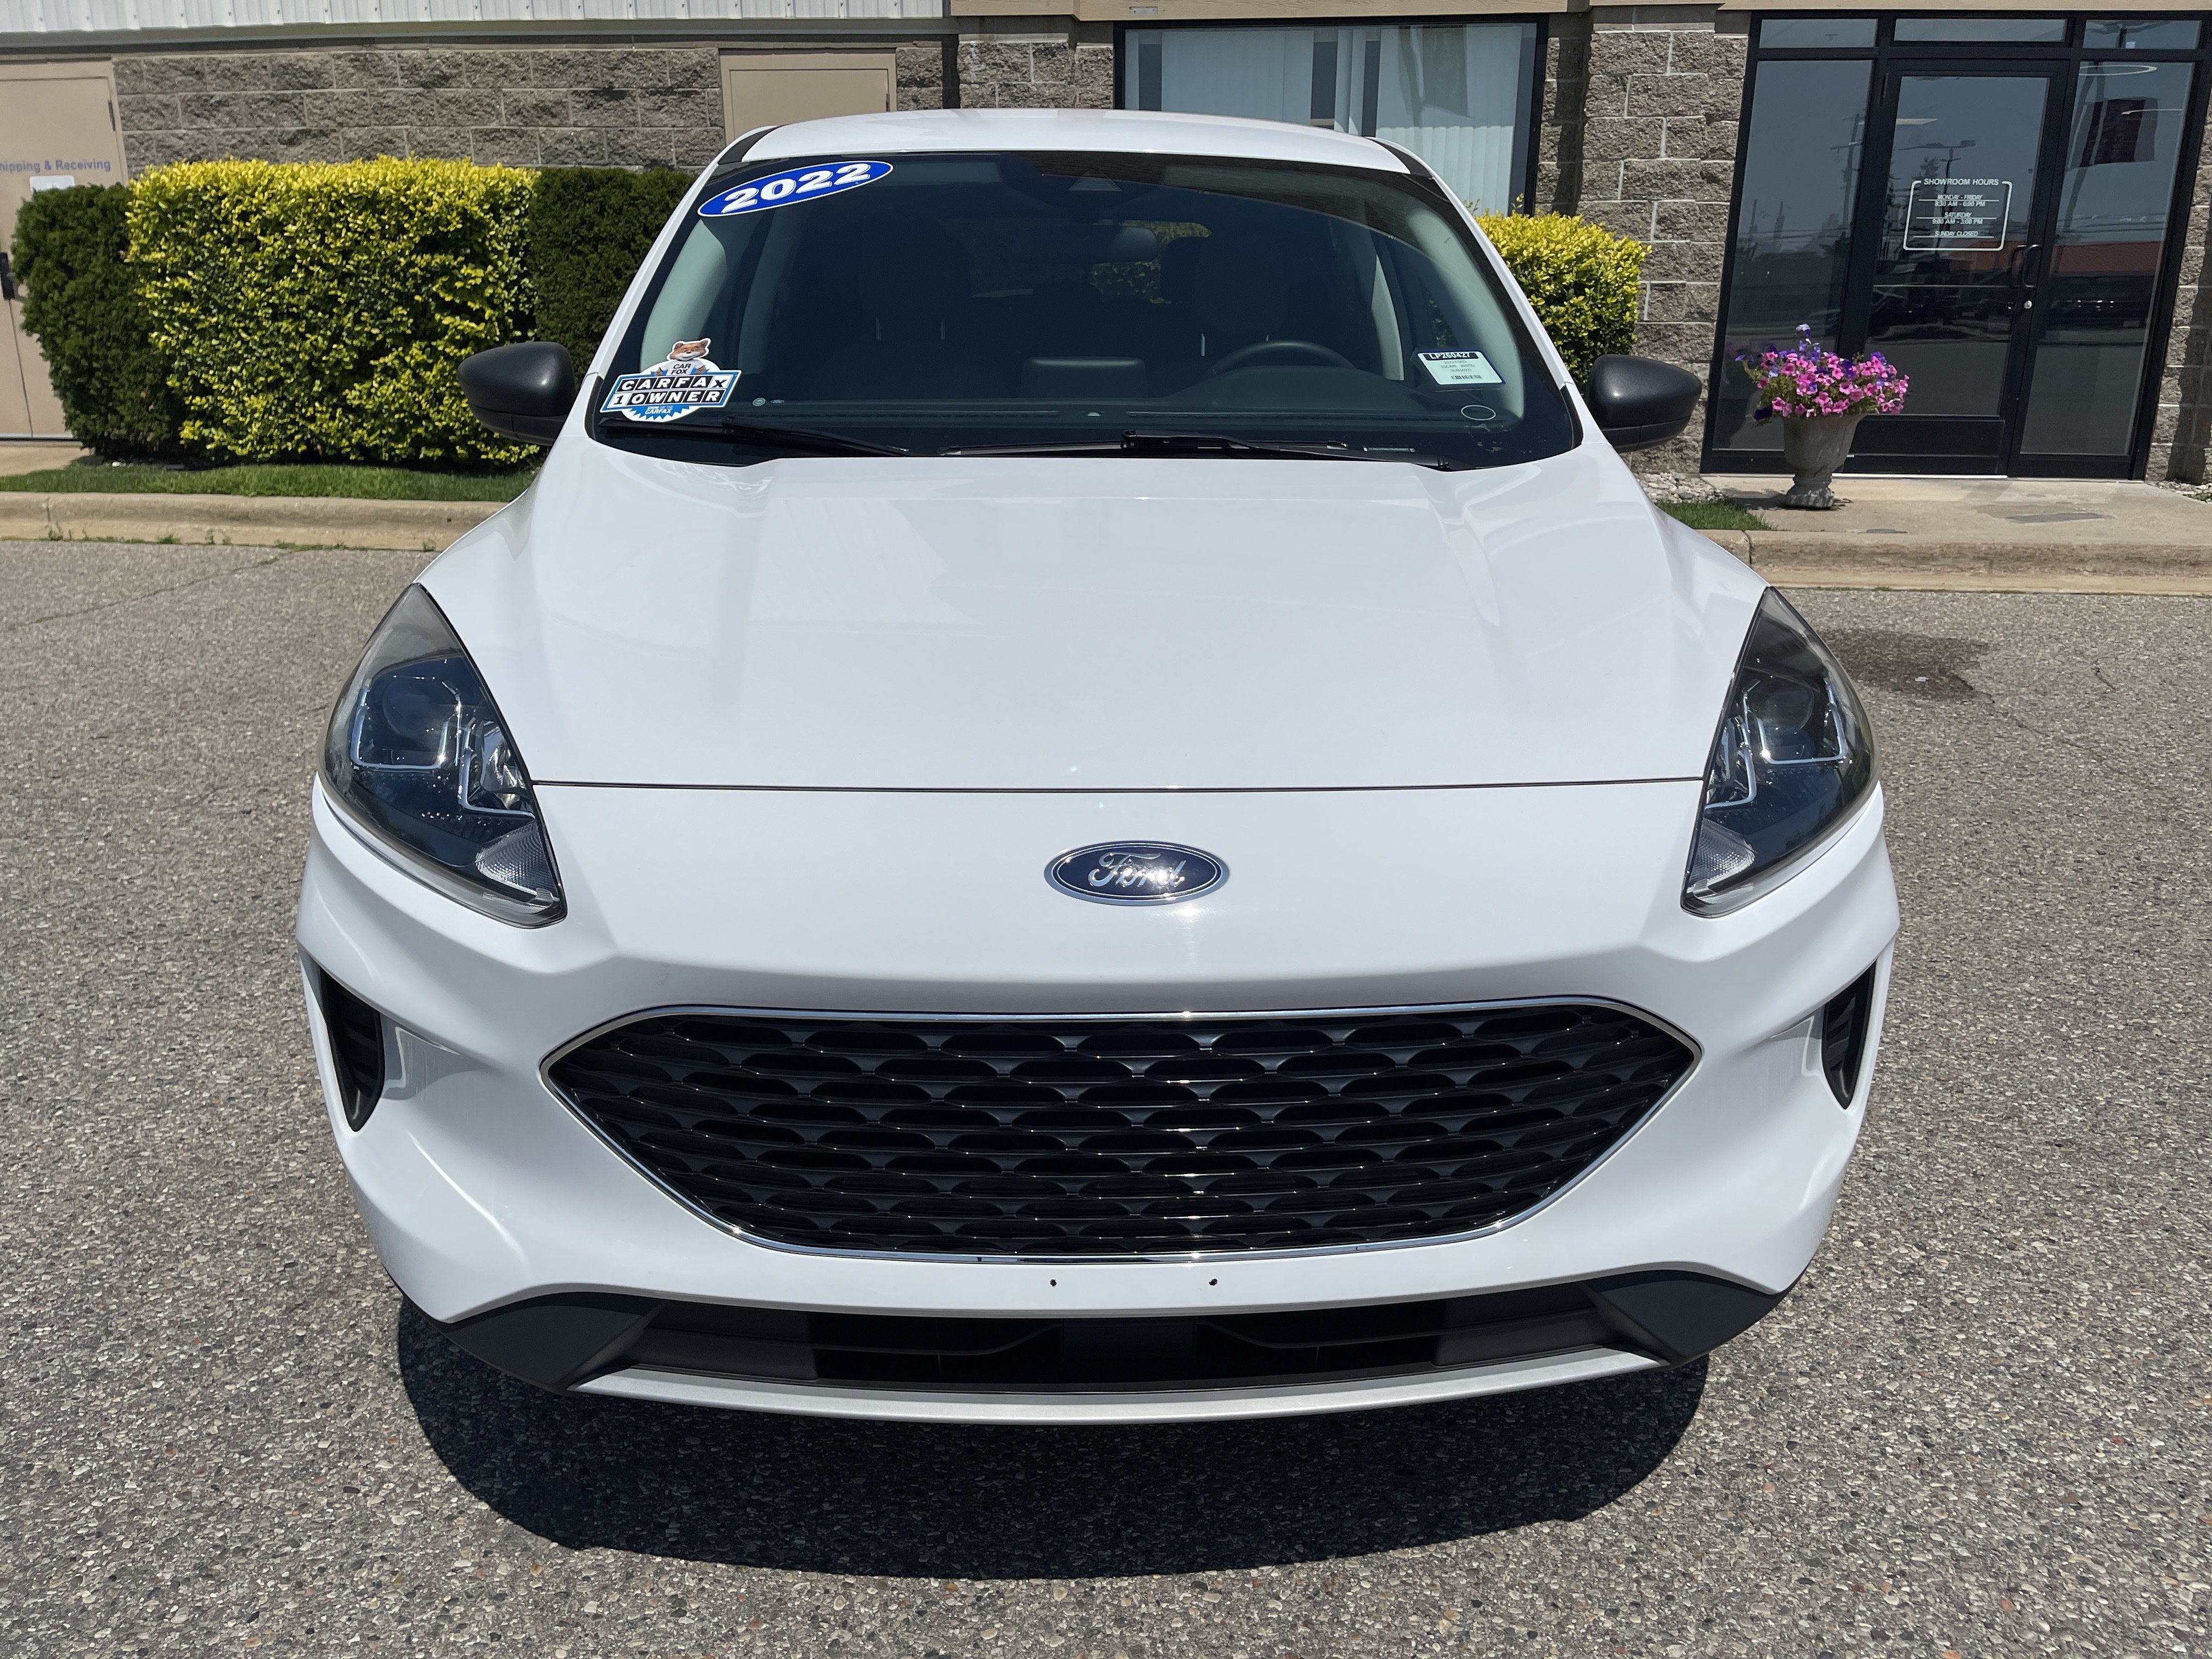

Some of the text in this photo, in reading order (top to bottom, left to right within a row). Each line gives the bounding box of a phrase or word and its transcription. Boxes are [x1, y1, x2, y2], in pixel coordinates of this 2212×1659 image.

[44, 159, 52, 170] &
[55, 158, 111, 172] Receiving
[721, 163, 871, 213] 2022
[622, 376, 727, 391] CARFAX
[613, 391, 721, 405] 1 OWNER
[1088, 852, 1187, 887] Ford
